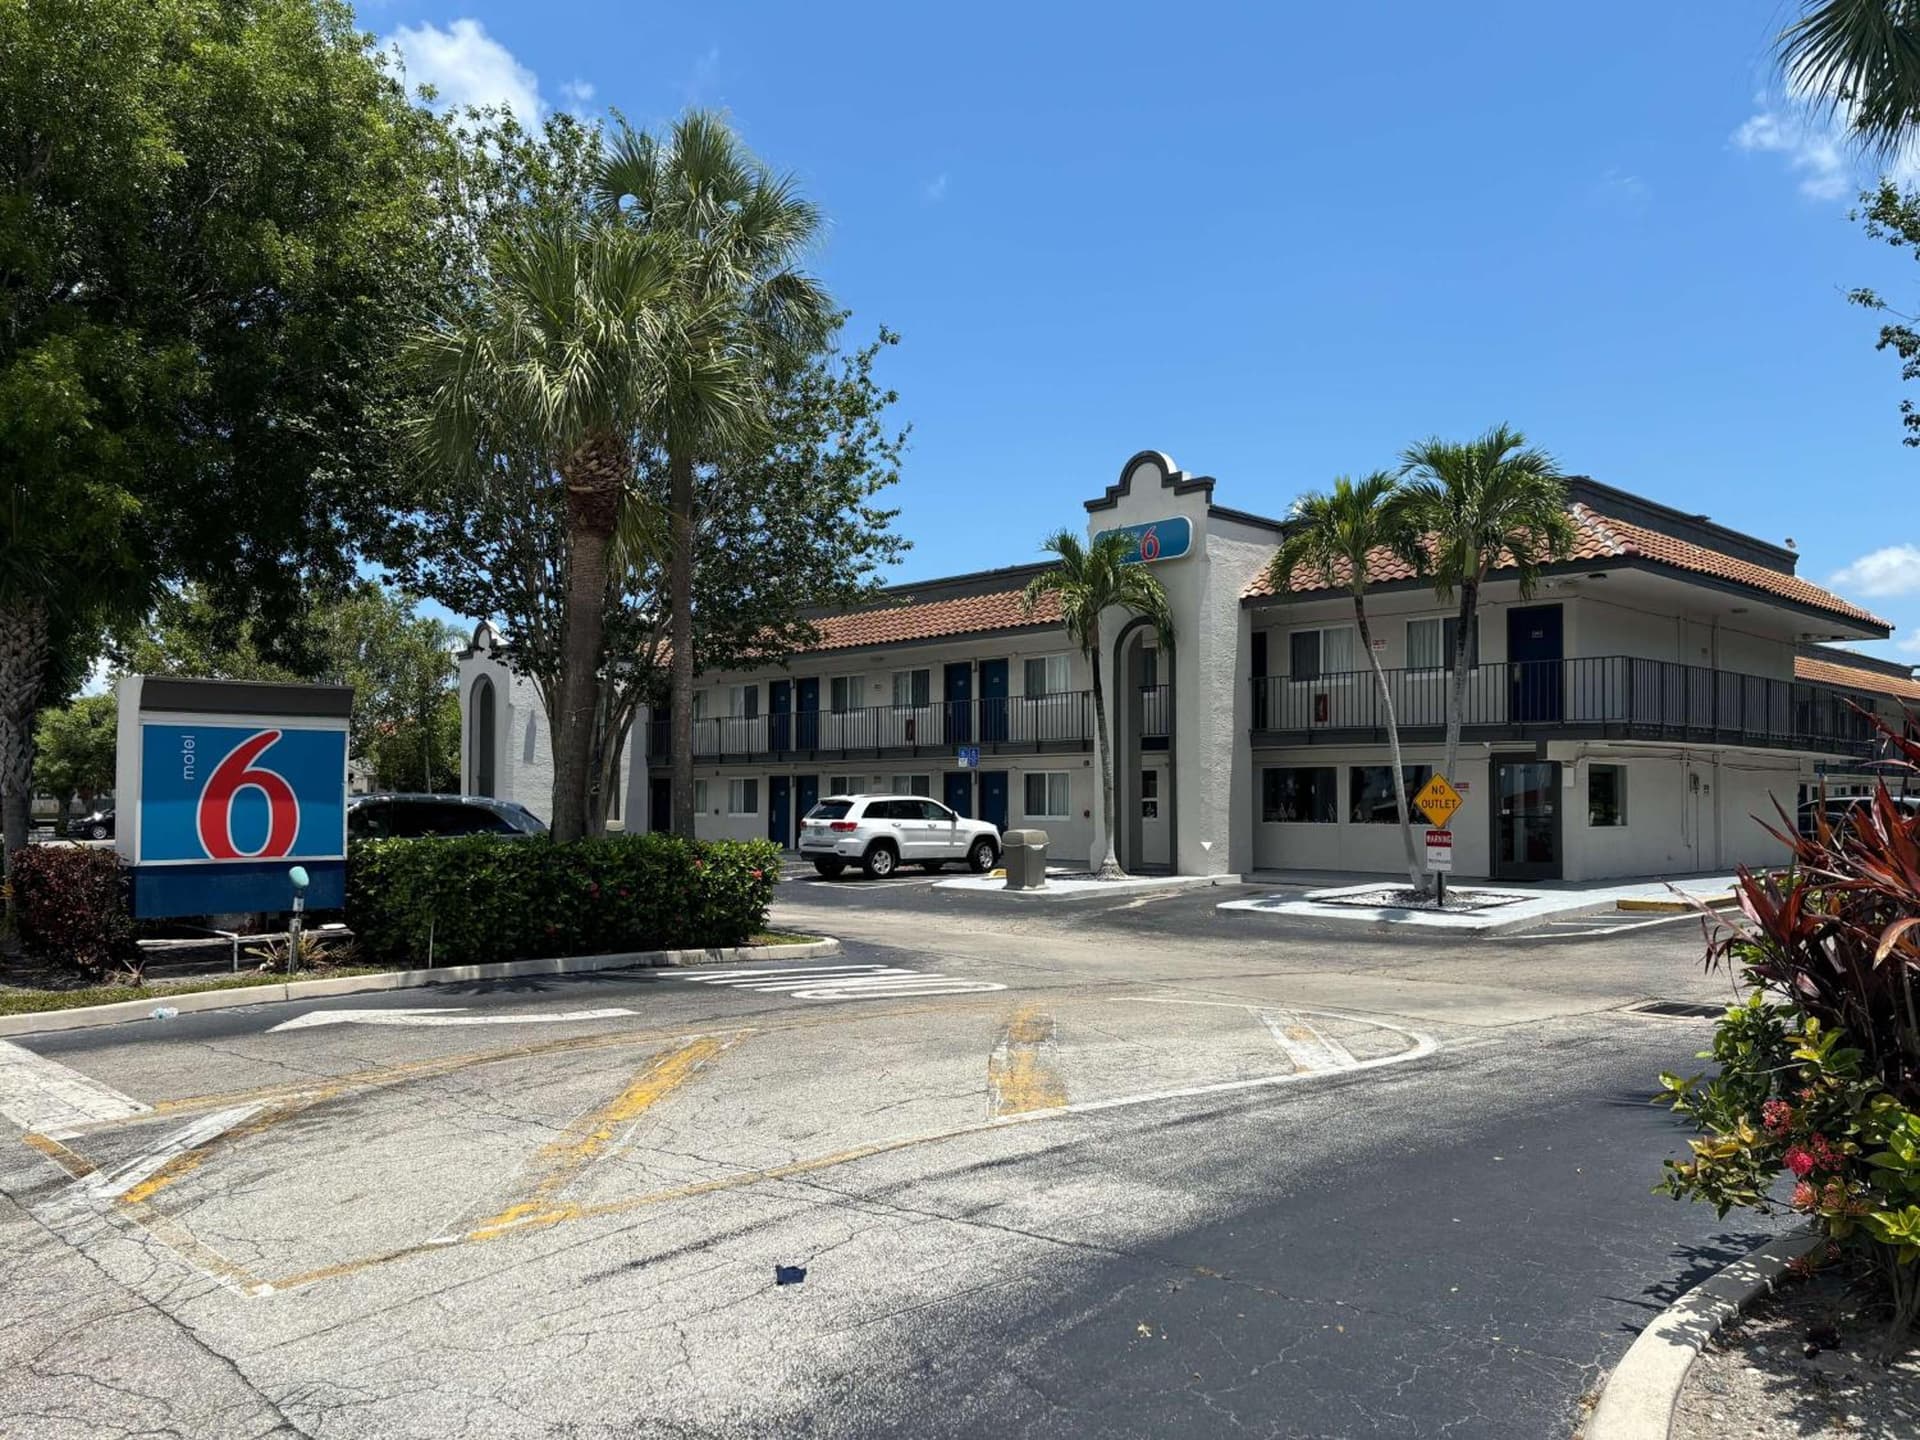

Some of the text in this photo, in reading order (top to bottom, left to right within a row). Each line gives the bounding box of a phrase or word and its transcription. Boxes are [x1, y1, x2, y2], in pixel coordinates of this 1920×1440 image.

[1141, 525, 1160, 562] 6
[181, 729, 301, 860] motel 6
[1421, 799, 1457, 809] OUTLET
[1431, 785, 1445, 795] NO
[656, 964, 1009, 1000] ONLY
